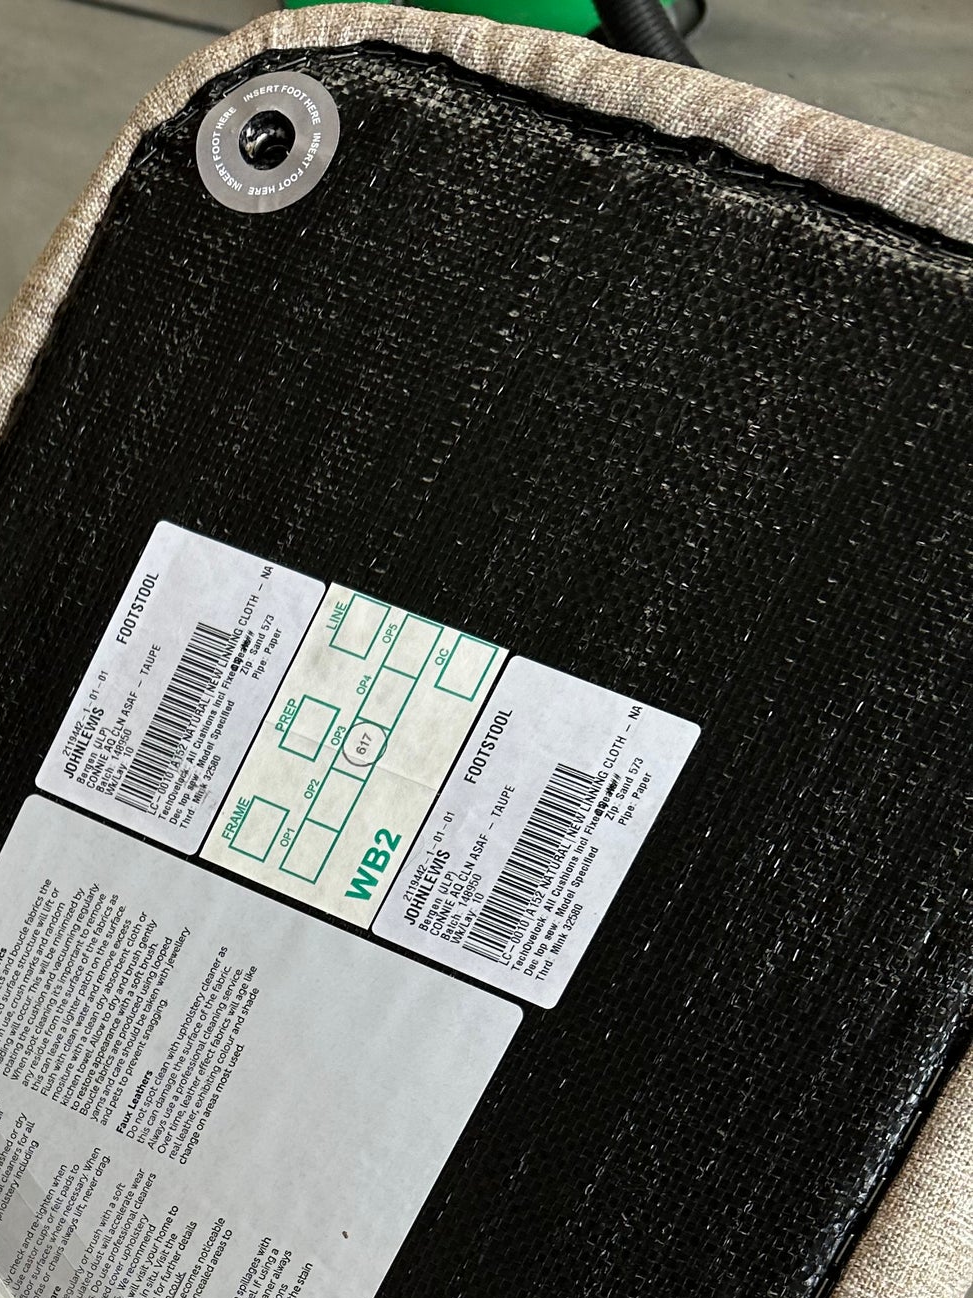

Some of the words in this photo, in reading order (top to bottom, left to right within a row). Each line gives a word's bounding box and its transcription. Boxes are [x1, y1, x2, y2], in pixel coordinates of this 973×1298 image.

[216, 106, 237, 130] HERE
[243, 84, 281, 103] INSERT
[280, 84, 308, 102] FOOT
[303, 97, 322, 126] HERE
[210, 132, 221, 162] FOOT
[304, 132, 322, 170] INSERT
[213, 158, 243, 192] INSERT
[247, 185, 276, 196] HERE
[278, 168, 305, 191] FOOT
[115, 573, 160, 646] FOOTSTOOL
[237, 594, 260, 627] CLOTH
[259, 565, 274, 580] NA
[325, 600, 348, 631] LINE
[249, 632, 266, 656] Sand
[260, 614, 275, 632] 573
[263, 627, 282, 656] Paper
[381, 622, 399, 645] OP5
[434, 647, 450, 666] QC
[355, 674, 373, 696] OP4
[85, 752, 110, 789] CONNIE
[110, 716, 127, 738] CLN
[120, 690, 138, 718] ASAF
[139, 643, 162, 676] TAUPE
[185, 750, 198, 765] All
[192, 709, 218, 750] Cushions
[211, 690, 227, 709] Incl
[274, 697, 298, 733] PREP
[330, 725, 347, 747] OP3
[63, 706, 105, 780] JOHNLEWIS
[76, 751, 99, 785] Bergen
[92, 726, 112, 750] (JLP)
[110, 727, 133, 761] 148950
[122, 745, 135, 758] 10
[355, 731, 373, 756] 617
[463, 709, 514, 785] FOOTSTOOL
[602, 735, 627, 769] CLOTH
[627, 705, 644, 721] NA
[168, 807, 183, 826] Dec
[195, 740, 216, 769] Model
[209, 699, 236, 741] Specified
[191, 782, 208, 805] Mink
[202, 754, 222, 782] 32580
[615, 775, 634, 801] Sand
[627, 757, 644, 775] 573
[303, 778, 321, 800] OP2
[630, 771, 652, 800] Paper
[220, 795, 251, 841] FRAME
[279, 826, 296, 848] OP1
[343, 827, 403, 901] WB2
[429, 898, 456, 937] CONNIE
[457, 860, 476, 882] CLN
[469, 833, 489, 862] ASAF
[490, 784, 516, 818] TAUPE
[542, 898, 557, 913] All
[550, 855, 580, 898] Cushions
[572, 836, 589, 855] Incl
[403, 849, 451, 926] JOHNLEWIS
[418, 897, 444, 932] Bergen
[437, 870, 458, 896] (JLP)
[457, 873, 483, 907] 148950
[471, 891, 485, 904] 10
[1, 956, 15, 976] and
[8, 926, 30, 958] boucle
[23, 895, 45, 926] fabrics
[38, 878, 53, 896] the
[523, 958, 539, 977] Dec
[554, 888, 577, 918] Model
[570, 845, 599, 888] Specified
[549, 932, 569, 956] Mink
[562, 903, 584, 932] 32580
[115, 1110, 134, 1135] Faux
[127, 1069, 154, 1111] Leathers
